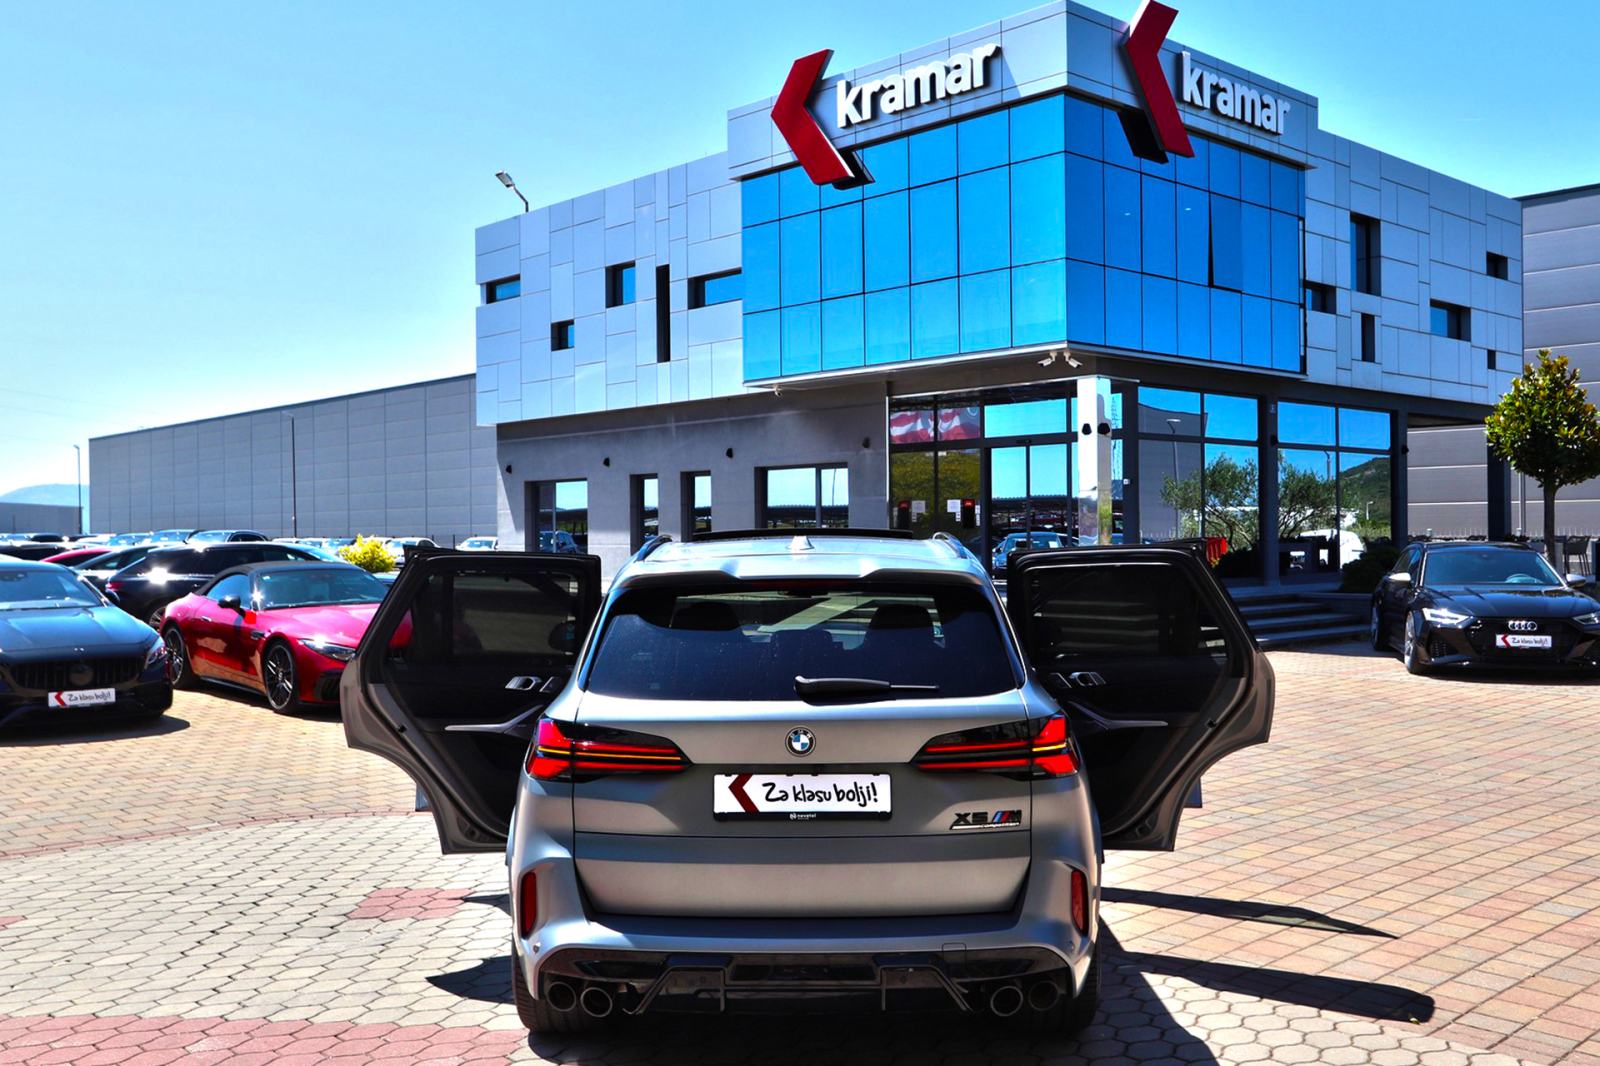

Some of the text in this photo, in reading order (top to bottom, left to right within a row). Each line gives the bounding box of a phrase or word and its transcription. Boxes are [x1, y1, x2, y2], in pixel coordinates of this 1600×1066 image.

[837, 43, 1000, 128] kramar
[1181, 50, 1291, 135] kramar
[762, 781, 878, 807] Za klasu bolji!
